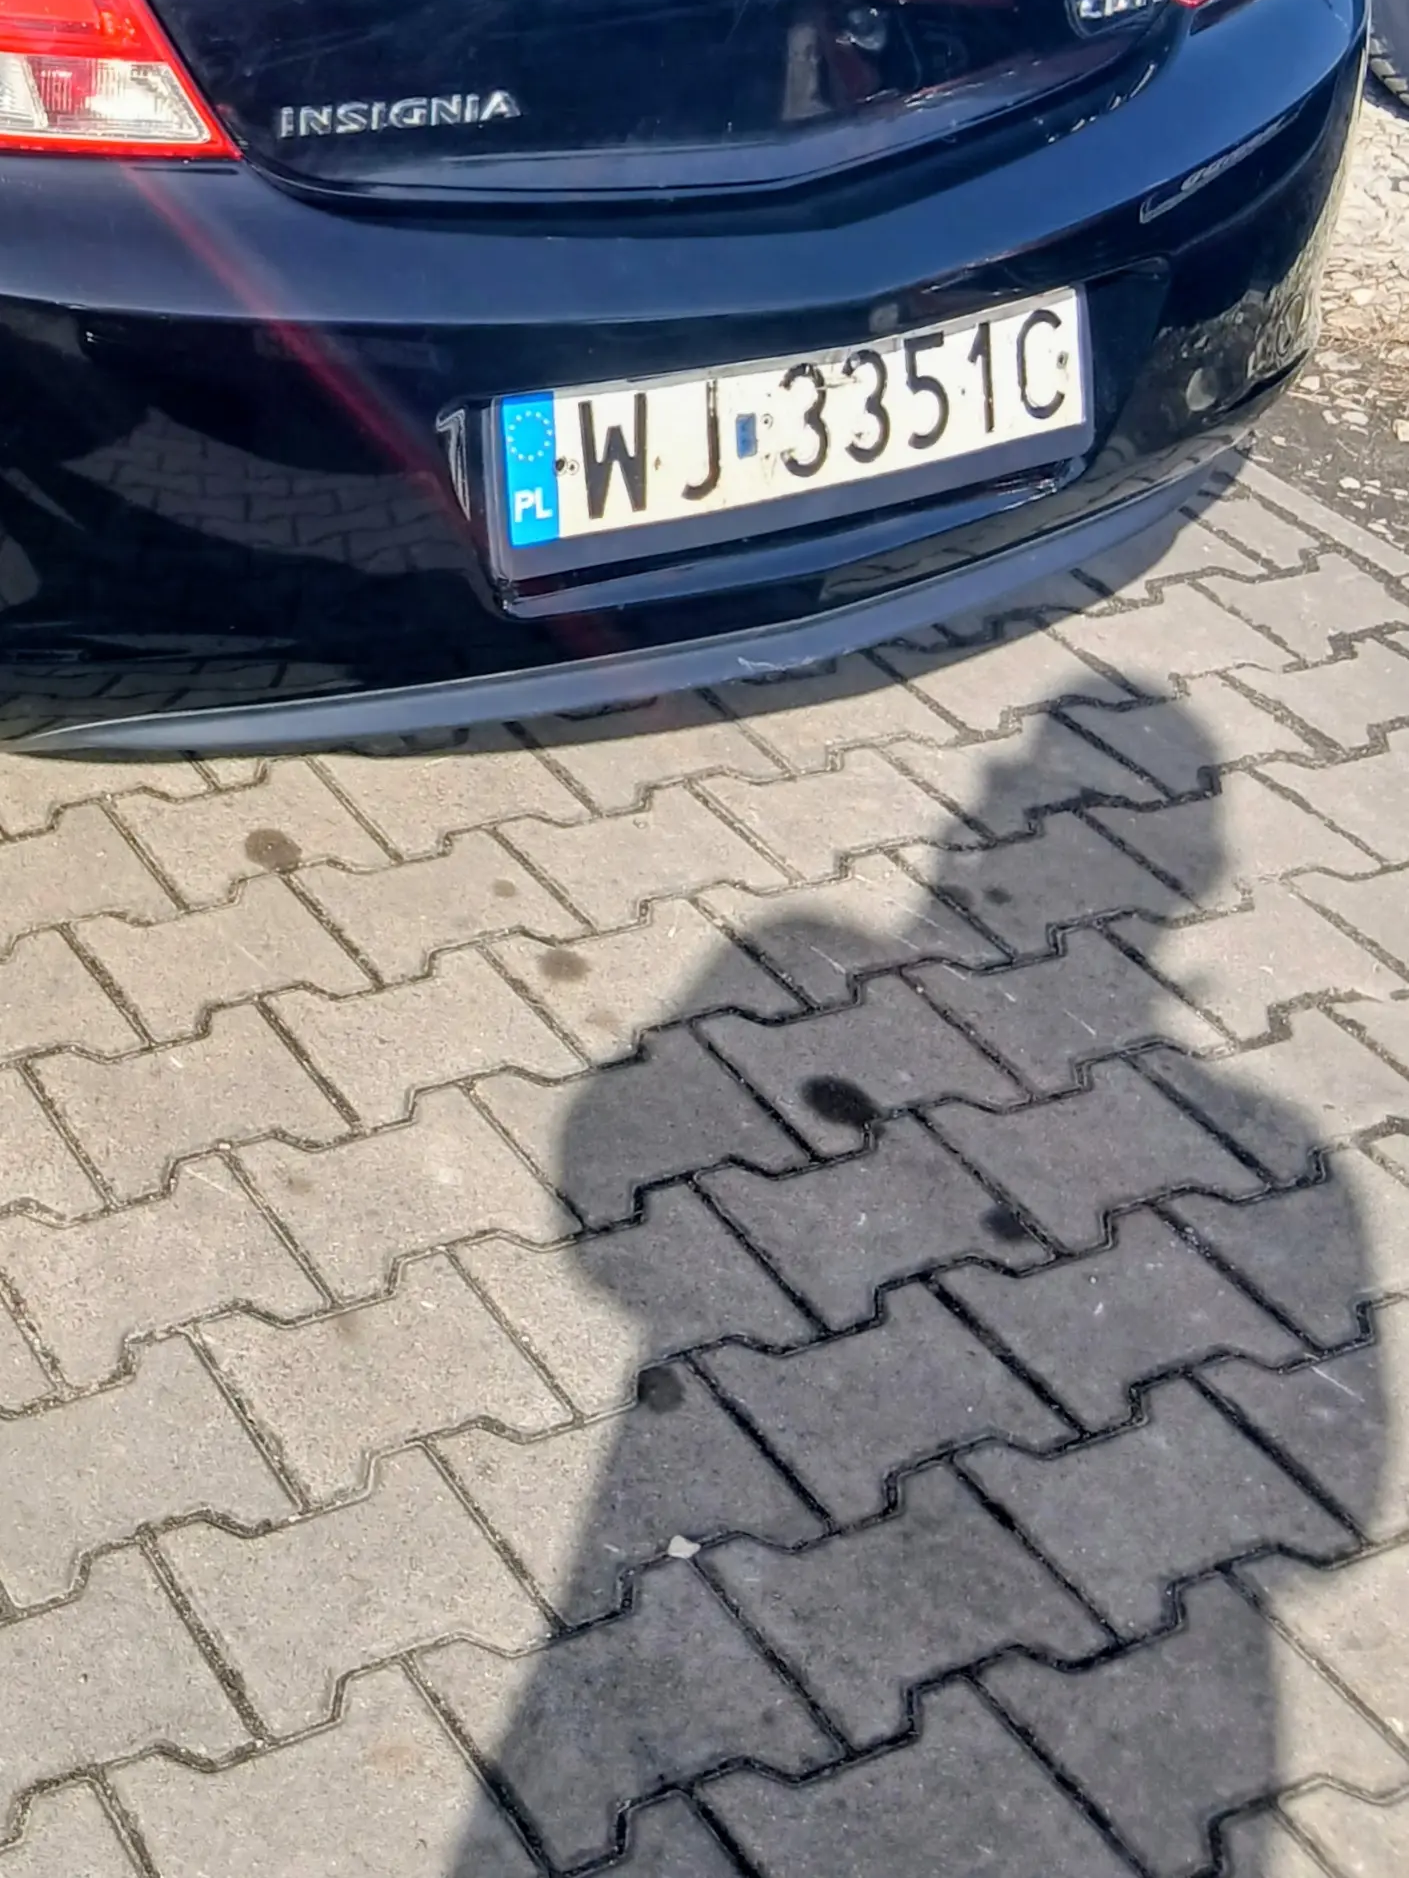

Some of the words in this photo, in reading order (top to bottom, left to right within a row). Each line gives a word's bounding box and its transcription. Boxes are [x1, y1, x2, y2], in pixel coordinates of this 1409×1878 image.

[280, 90, 522, 139] INSIGNIA
[577, 377, 722, 520] WJ
[778, 308, 1066, 478] 3351C
[514, 490, 553, 522] PL
